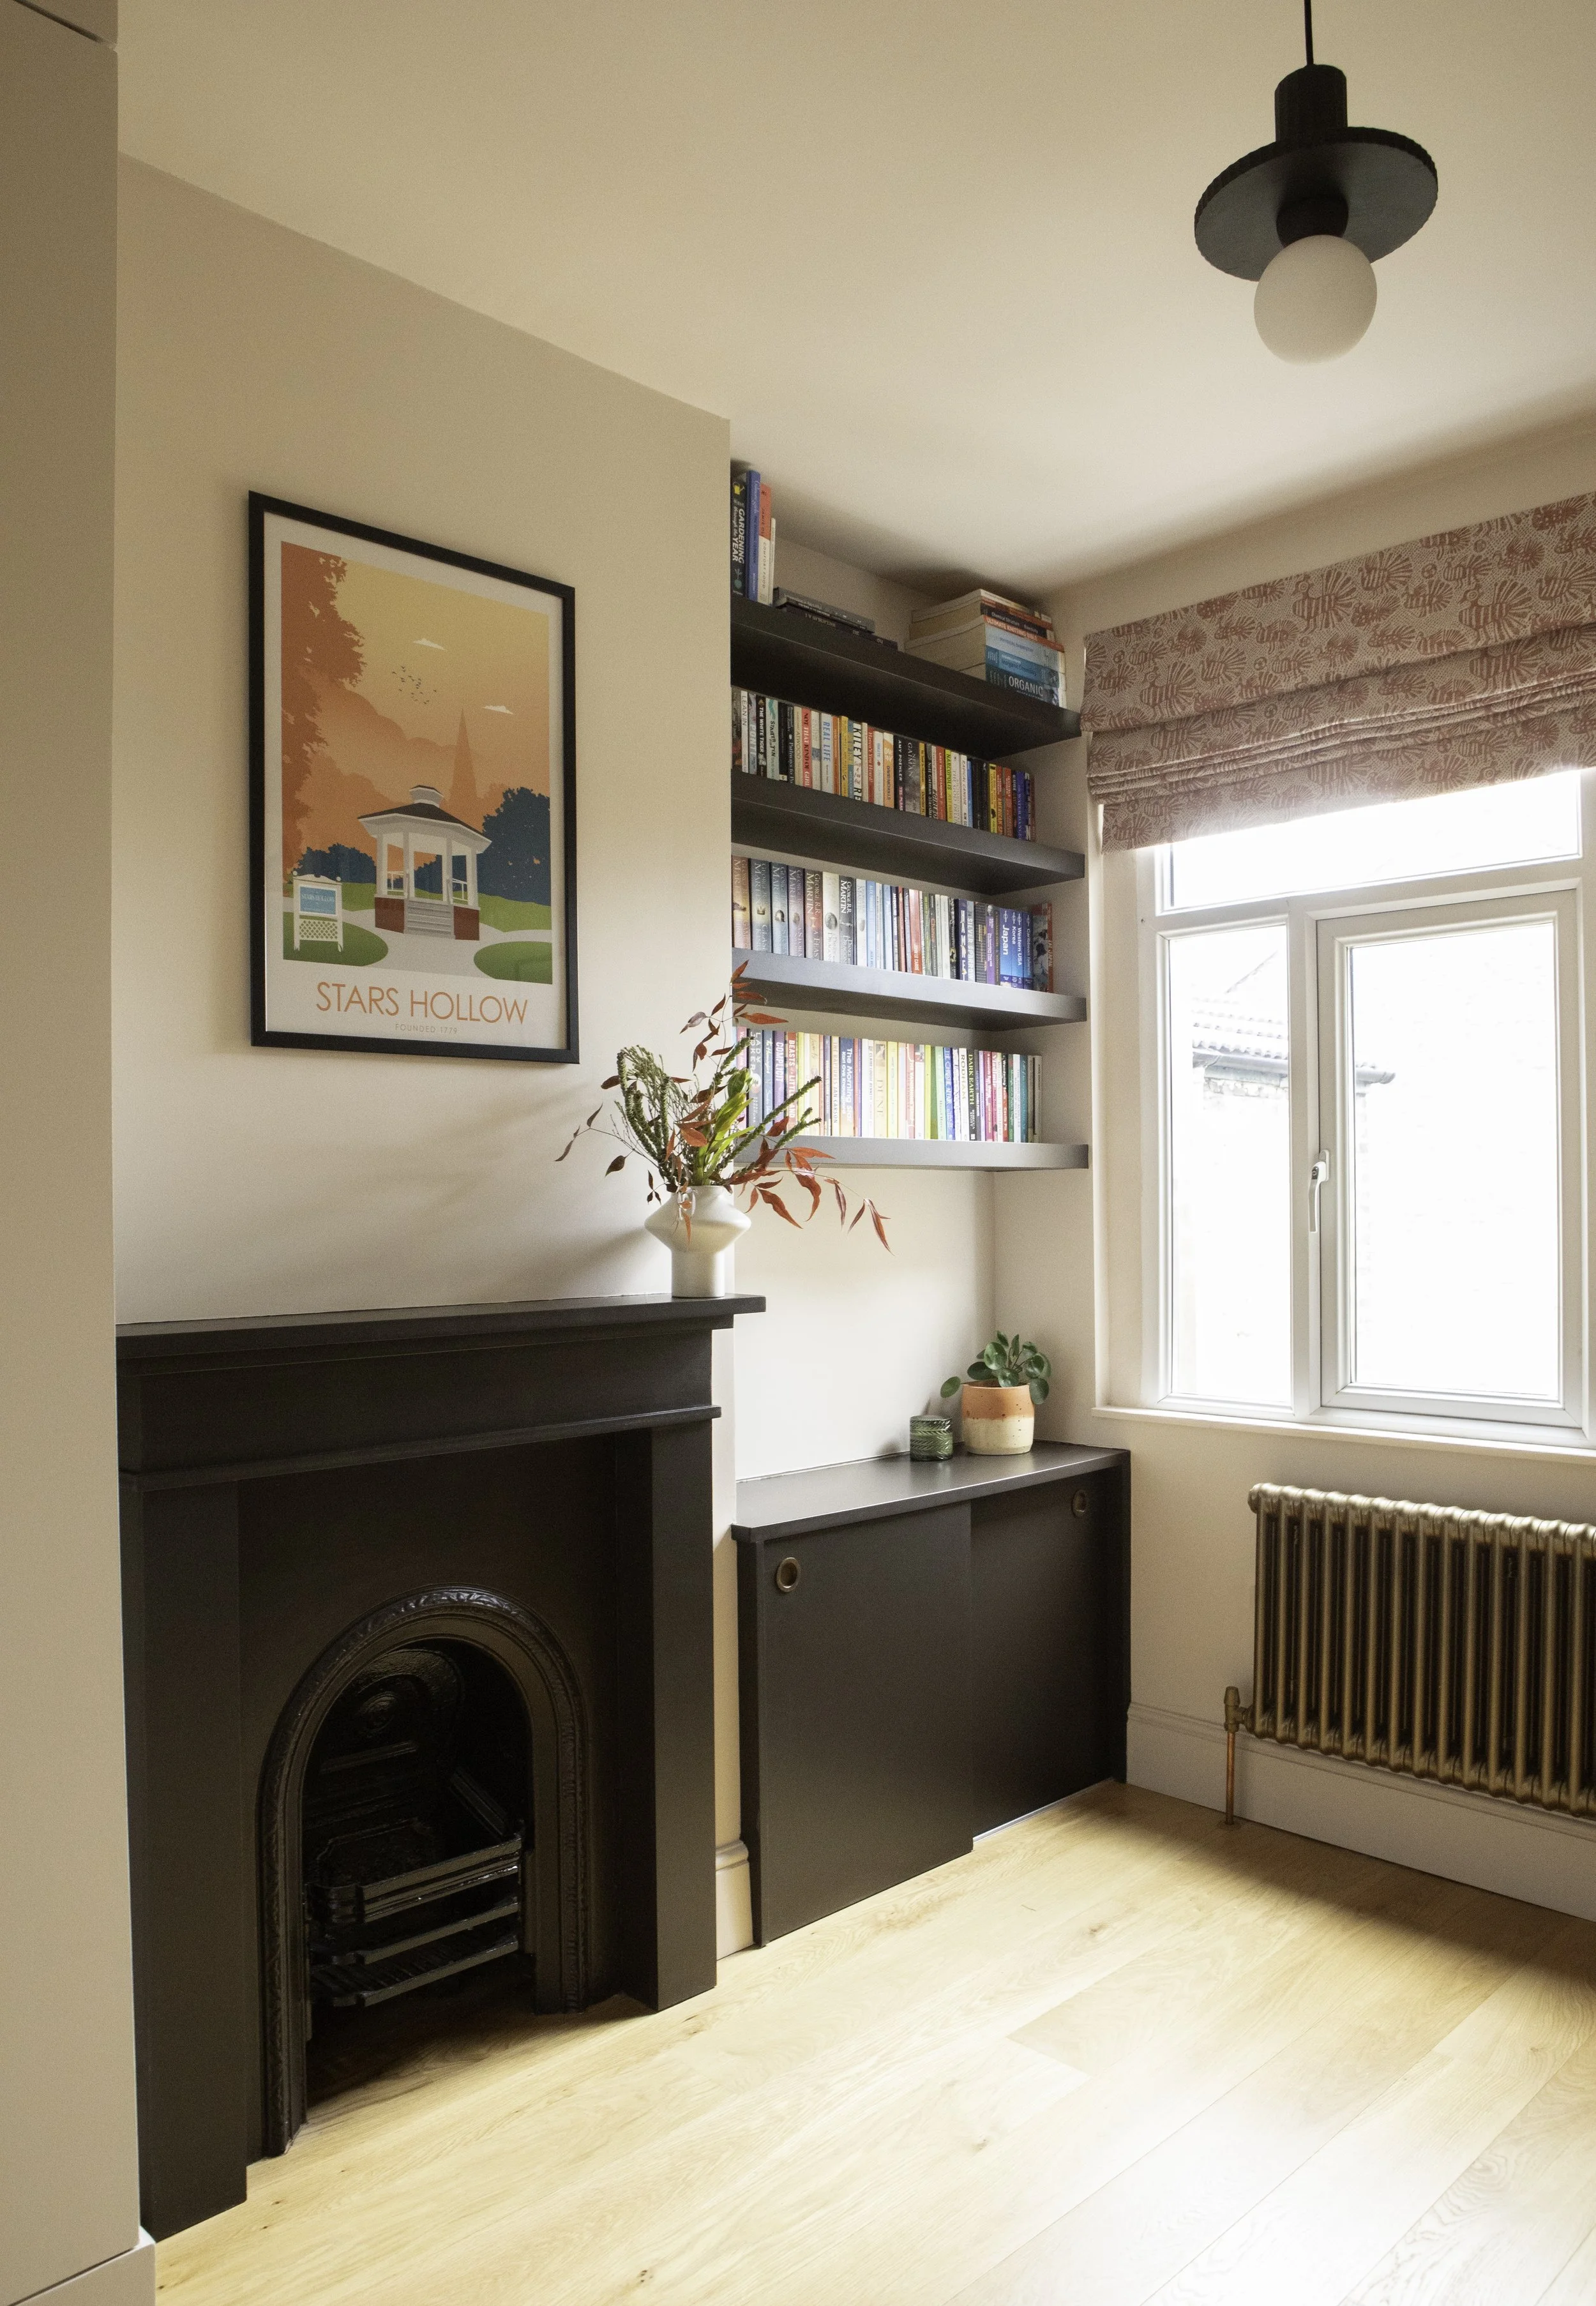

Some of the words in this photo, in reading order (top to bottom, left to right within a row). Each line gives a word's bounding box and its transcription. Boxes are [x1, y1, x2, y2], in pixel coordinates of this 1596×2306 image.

[1009, 675, 1044, 697] ORGANIC
[742, 718, 748, 727] IN
[823, 744, 831, 762] LIFE
[853, 727, 862, 760] KILEY
[806, 872, 815, 916] MARTIN
[1001, 924, 1010, 956] Japan
[316, 981, 400, 1016] STARS
[410, 990, 528, 1025] HOLLOW
[395, 1023, 437, 1034] FOUNDED
[440, 1026, 458, 1035] 1779
